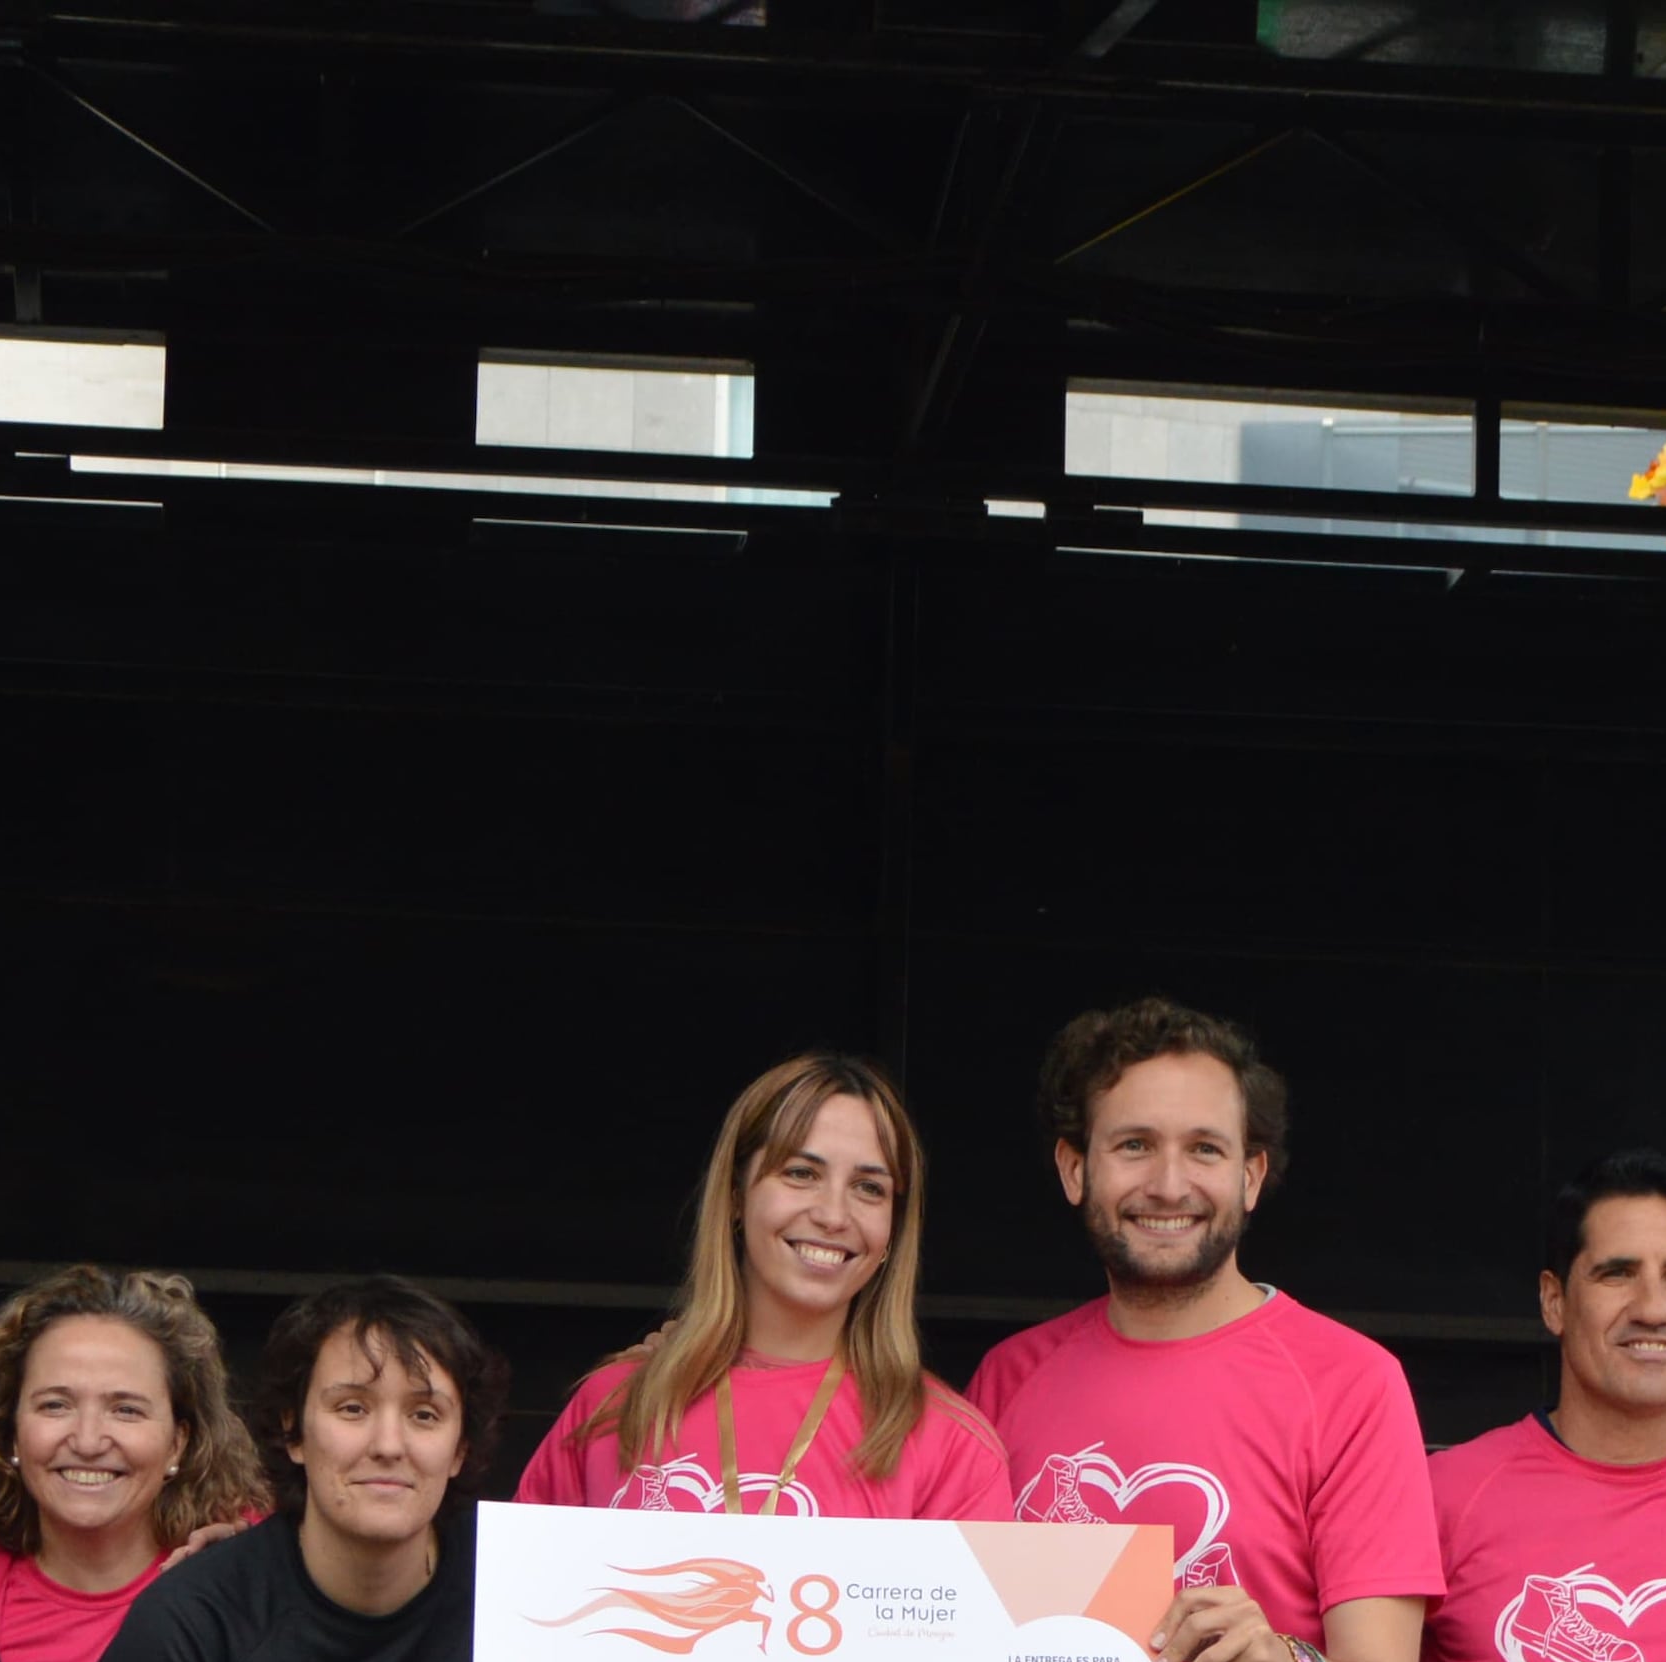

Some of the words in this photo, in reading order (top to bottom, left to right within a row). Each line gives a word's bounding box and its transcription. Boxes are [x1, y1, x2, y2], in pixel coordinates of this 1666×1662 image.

[846, 1583, 923, 1600] Carrera
[930, 1585, 958, 1601] de
[786, 1574, 843, 1656] 8
[876, 1604, 894, 1620] la
[901, 1605, 956, 1624] Mujer
